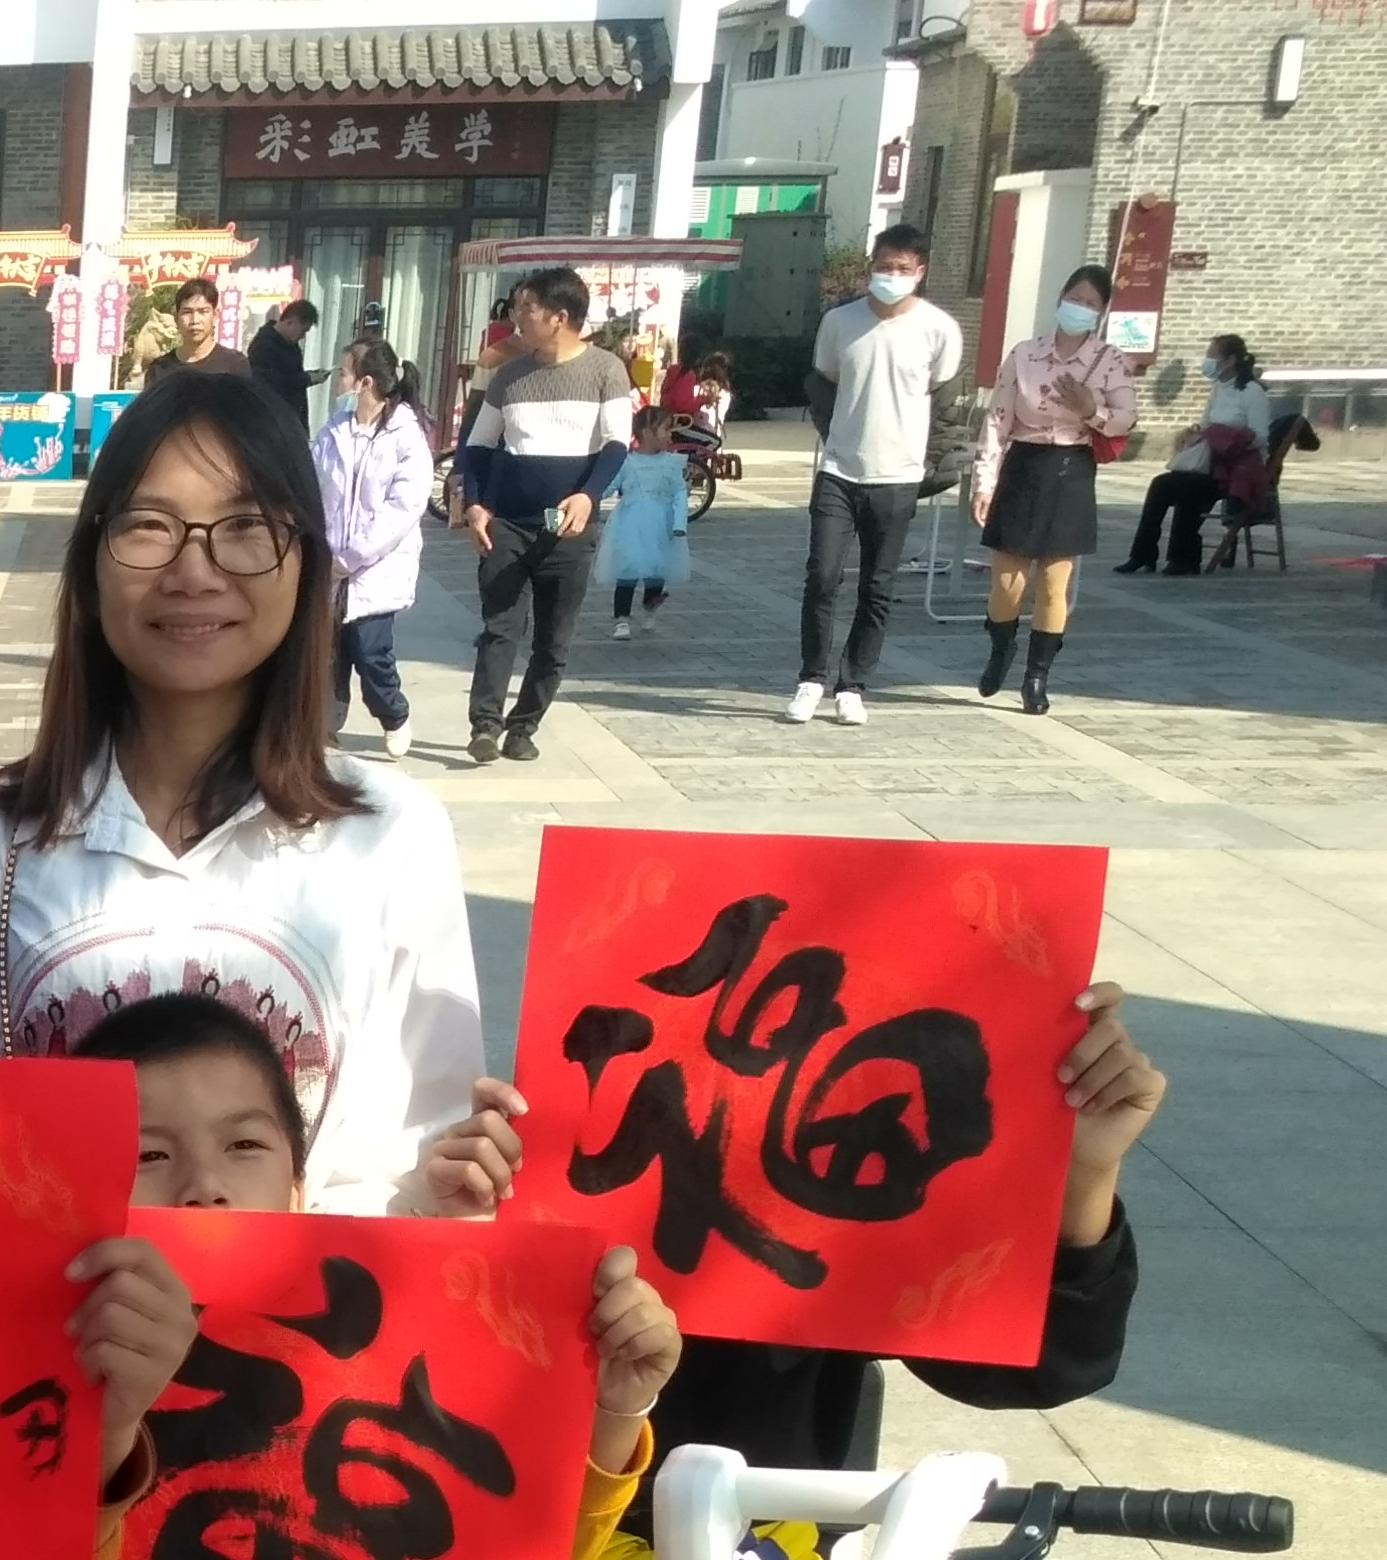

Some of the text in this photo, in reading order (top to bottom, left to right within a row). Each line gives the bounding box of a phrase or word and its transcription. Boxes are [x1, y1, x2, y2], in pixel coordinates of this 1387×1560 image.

[255, 108, 494, 163] 彩虹美学
[562, 894, 993, 1290] 福
